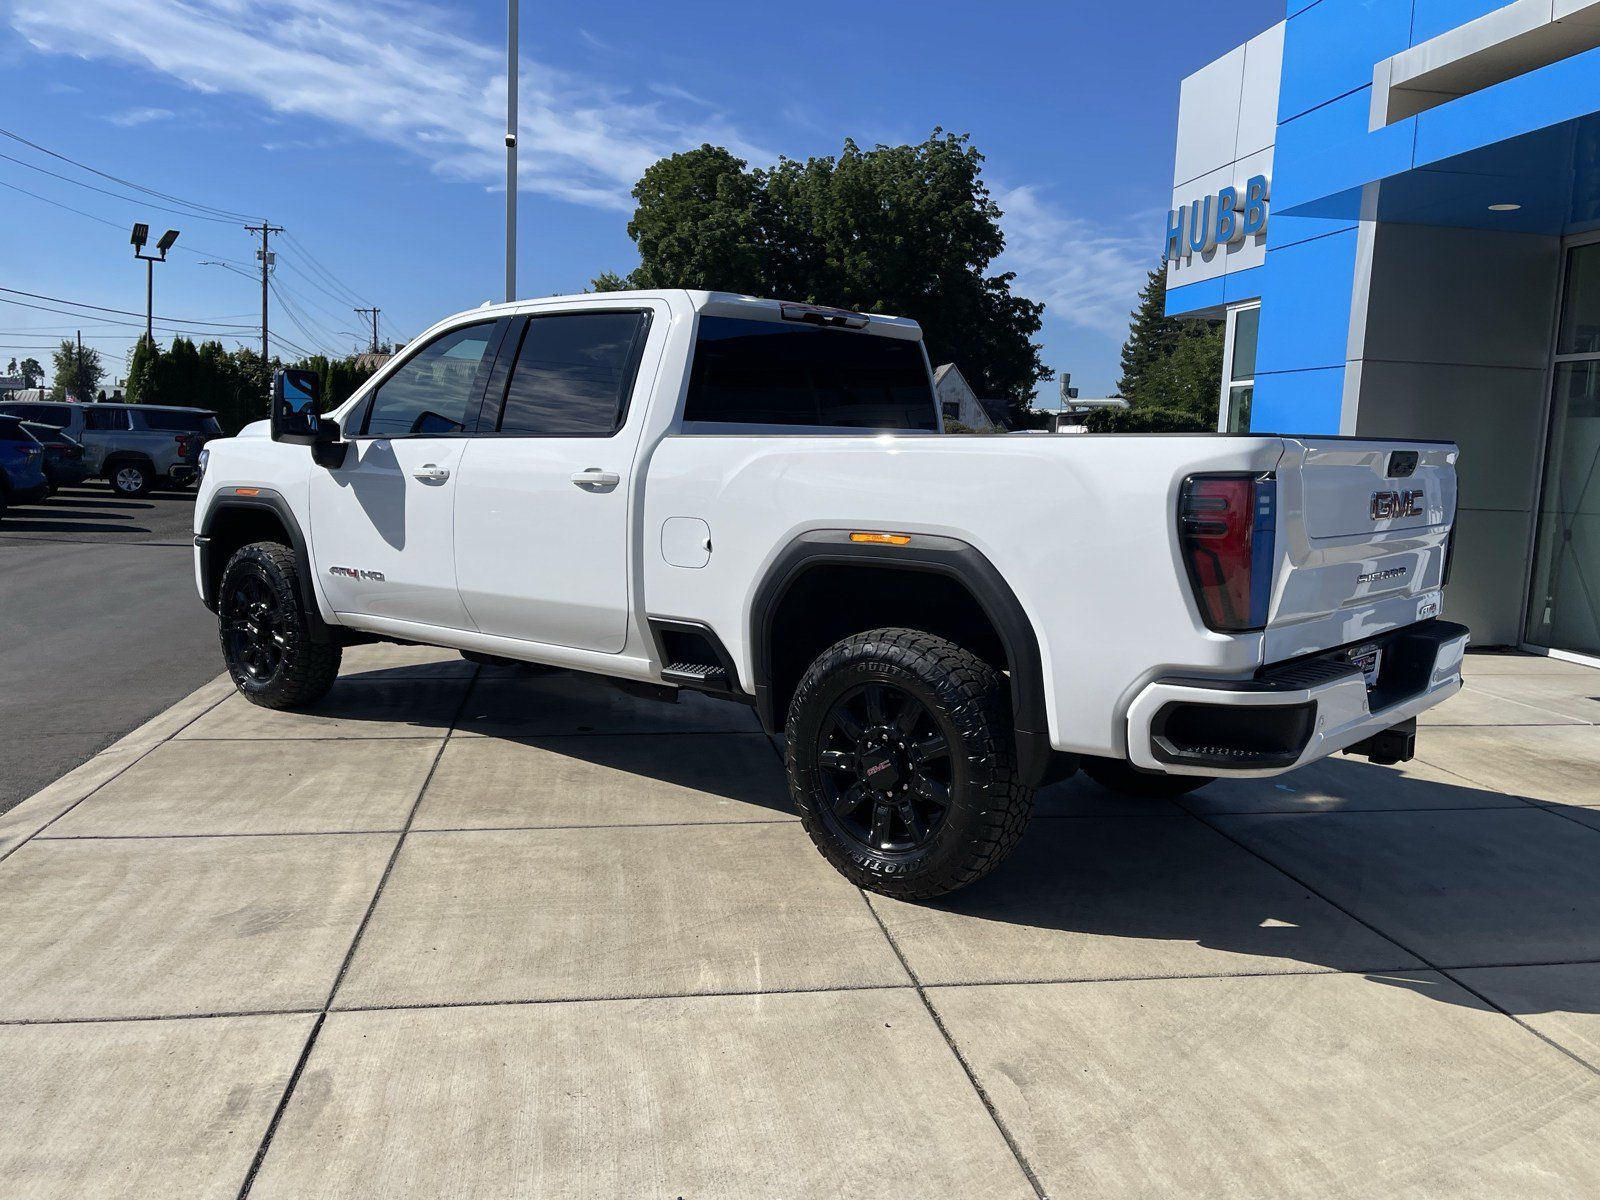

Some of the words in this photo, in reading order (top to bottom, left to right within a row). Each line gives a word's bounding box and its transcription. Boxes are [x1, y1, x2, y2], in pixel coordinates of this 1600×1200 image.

[1165, 174, 1266, 261] HUBB
[1370, 489, 1424, 520] GMC
[1357, 566, 1407, 584] SIERRA
